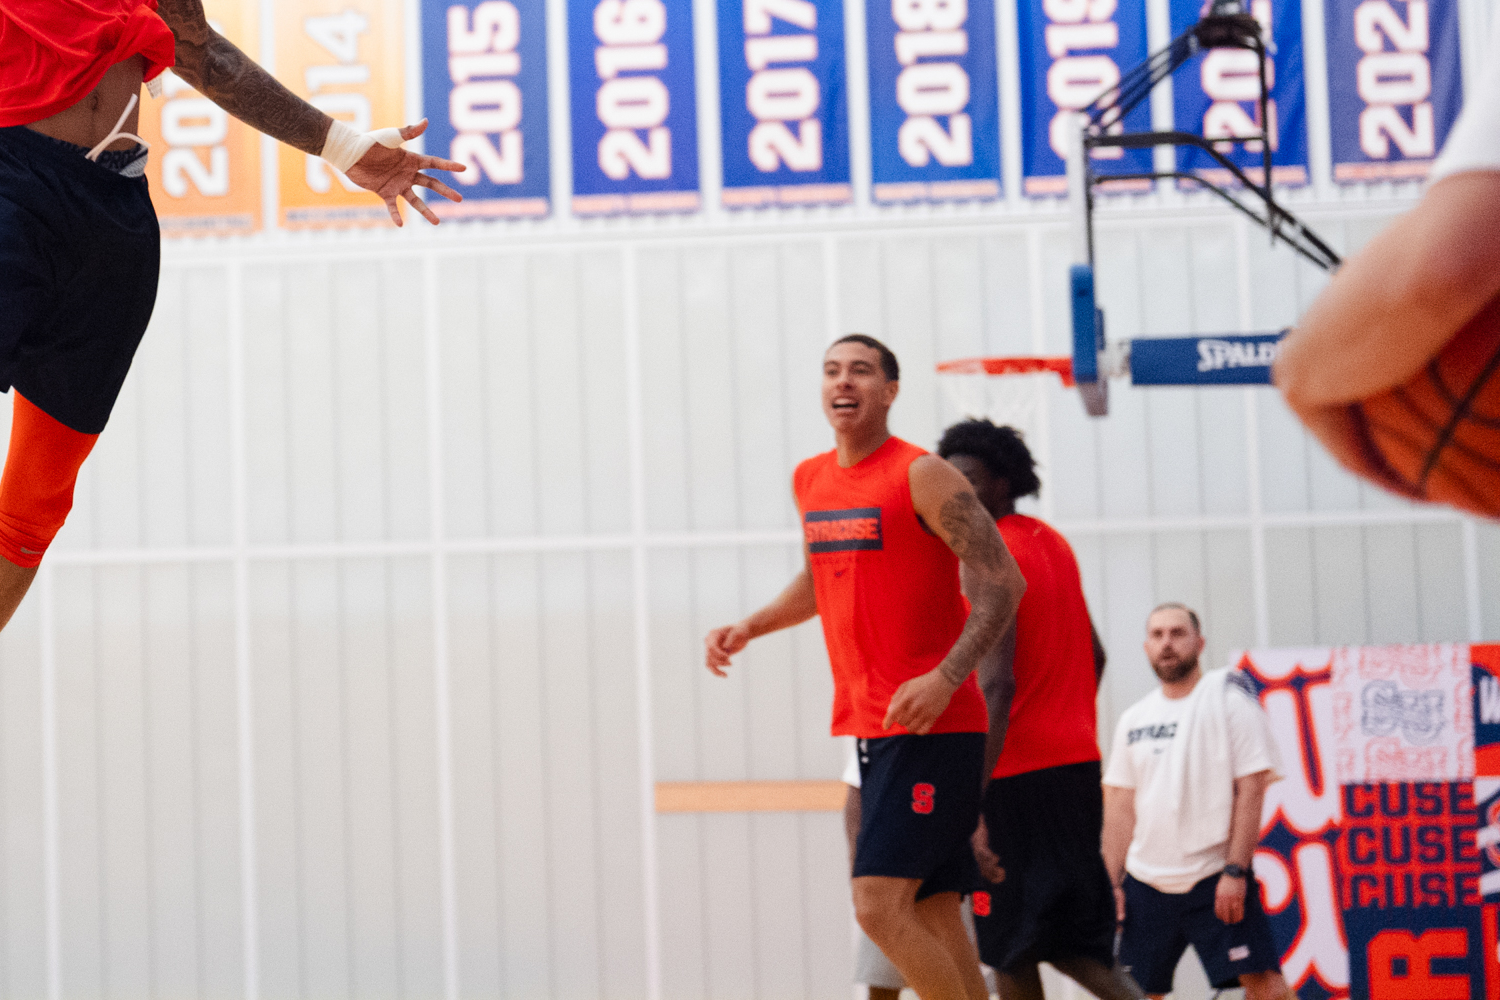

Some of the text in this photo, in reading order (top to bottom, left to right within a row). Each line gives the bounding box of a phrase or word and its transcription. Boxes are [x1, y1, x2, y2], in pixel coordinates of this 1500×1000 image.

[447, 0, 523, 184] 2015
[1197, 338, 1276, 372] SPALD
[912, 782, 936, 814] S
[1345, 782, 1477, 818] CUSE
[1348, 825, 1480, 866] CUSE
